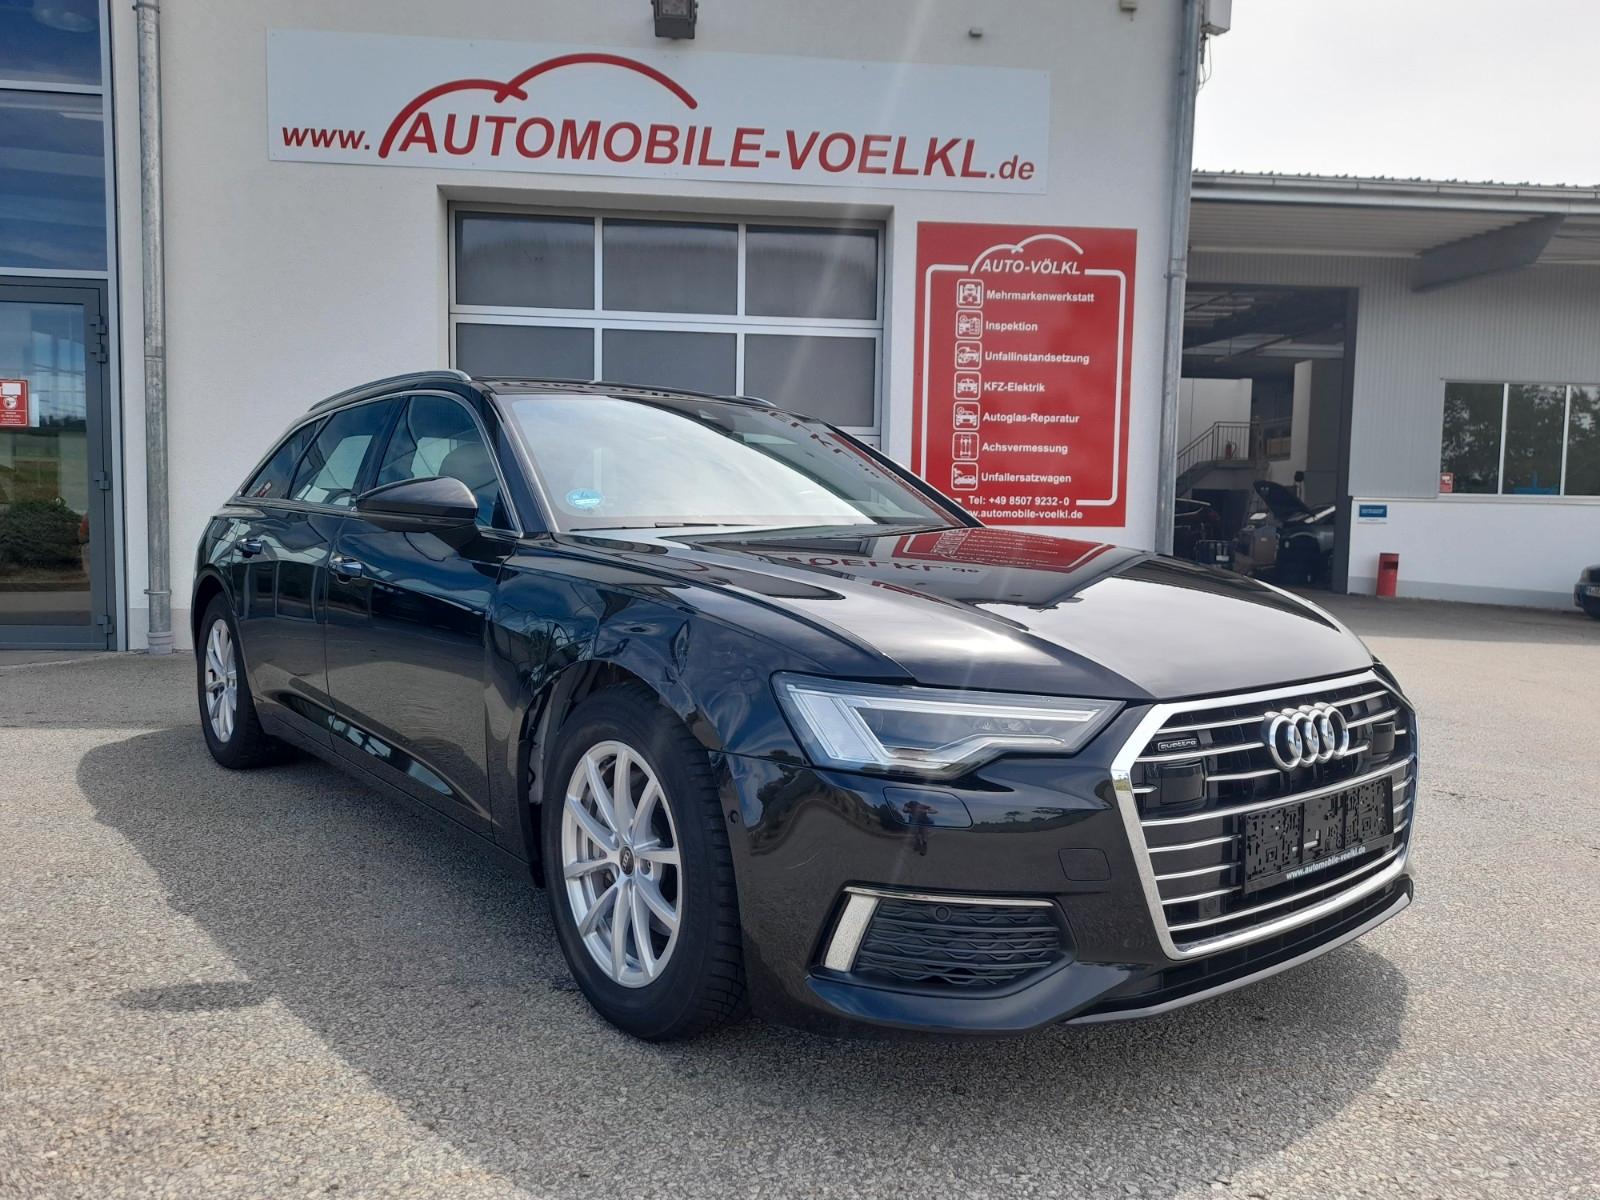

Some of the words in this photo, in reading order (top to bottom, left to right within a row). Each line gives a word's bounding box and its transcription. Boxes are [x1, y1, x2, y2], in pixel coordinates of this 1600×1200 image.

[282, 127, 370, 150] www.
[980, 259, 1081, 275] AUTO-VÖLKL
[986, 290, 1095, 303] Mehrmarkenwerkstatt
[985, 321, 1038, 333] Inspektion
[985, 351, 1090, 366] Unfallinstandsetzung
[983, 381, 1045, 393] KFZ-Elektrik
[982, 412, 1080, 424] Autoglas-Reparatur
[981, 442, 1069, 455] Achsvermessung
[981, 472, 1072, 484] Unfallersatzwagen
[968, 495, 986, 505] Tel:
[988, 496, 1007, 506] +49
[1009, 496, 1033, 506] 8507
[967, 508, 1084, 519] w.automobile-voelkl.de
